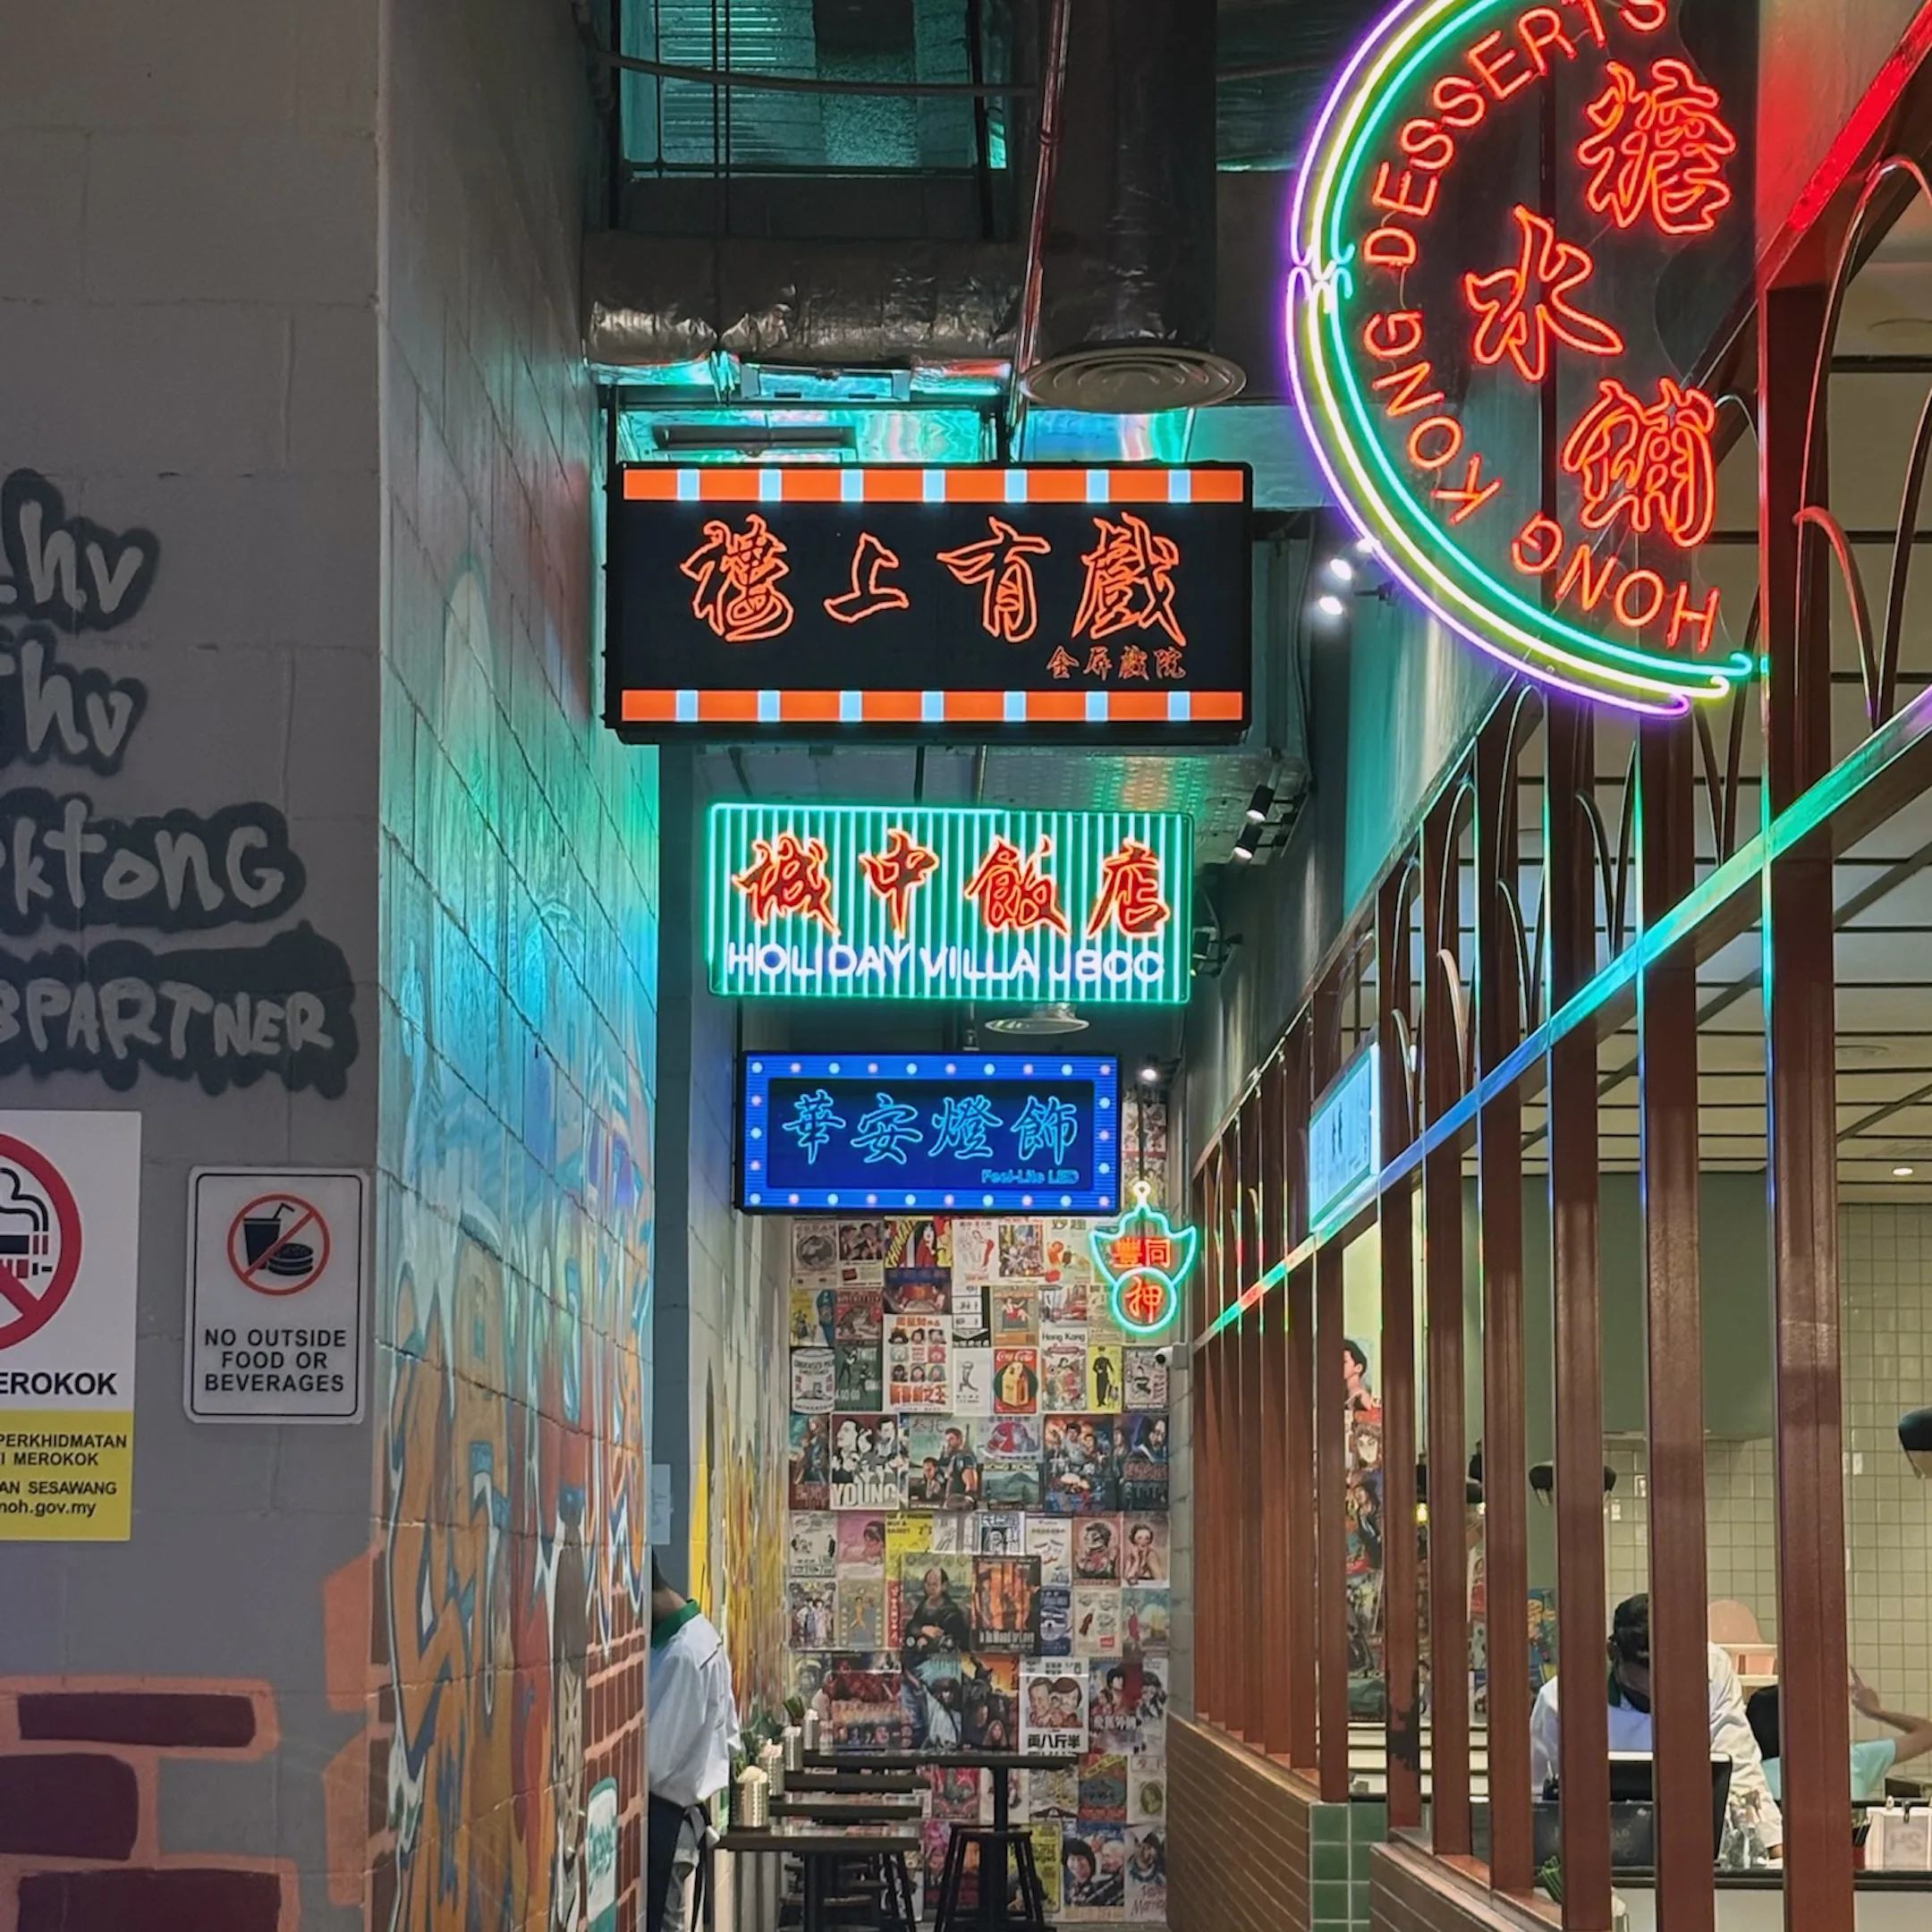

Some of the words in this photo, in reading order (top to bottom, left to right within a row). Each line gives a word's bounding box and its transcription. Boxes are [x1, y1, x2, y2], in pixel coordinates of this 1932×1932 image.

[1362, 0, 1668, 267] DESSERTS
[1364, 309, 1503, 525] KONG
[1511, 512, 1721, 652] HONG
[0, 640, 132, 758] hv
[726, 942, 913, 978] HOLIDAY
[919, 946, 1039, 980] VILLA
[205, 1329, 236, 1347] NO
[248, 1329, 347, 1347] OUTSIDE
[222, 1351, 285, 1369] FOOD
[296, 1351, 327, 1369] OR
[205, 1373, 345, 1393] BEVERAGES
[13, 1452, 99, 1466] MEROKOK
[28, 1480, 117, 1496] SESAWANG
